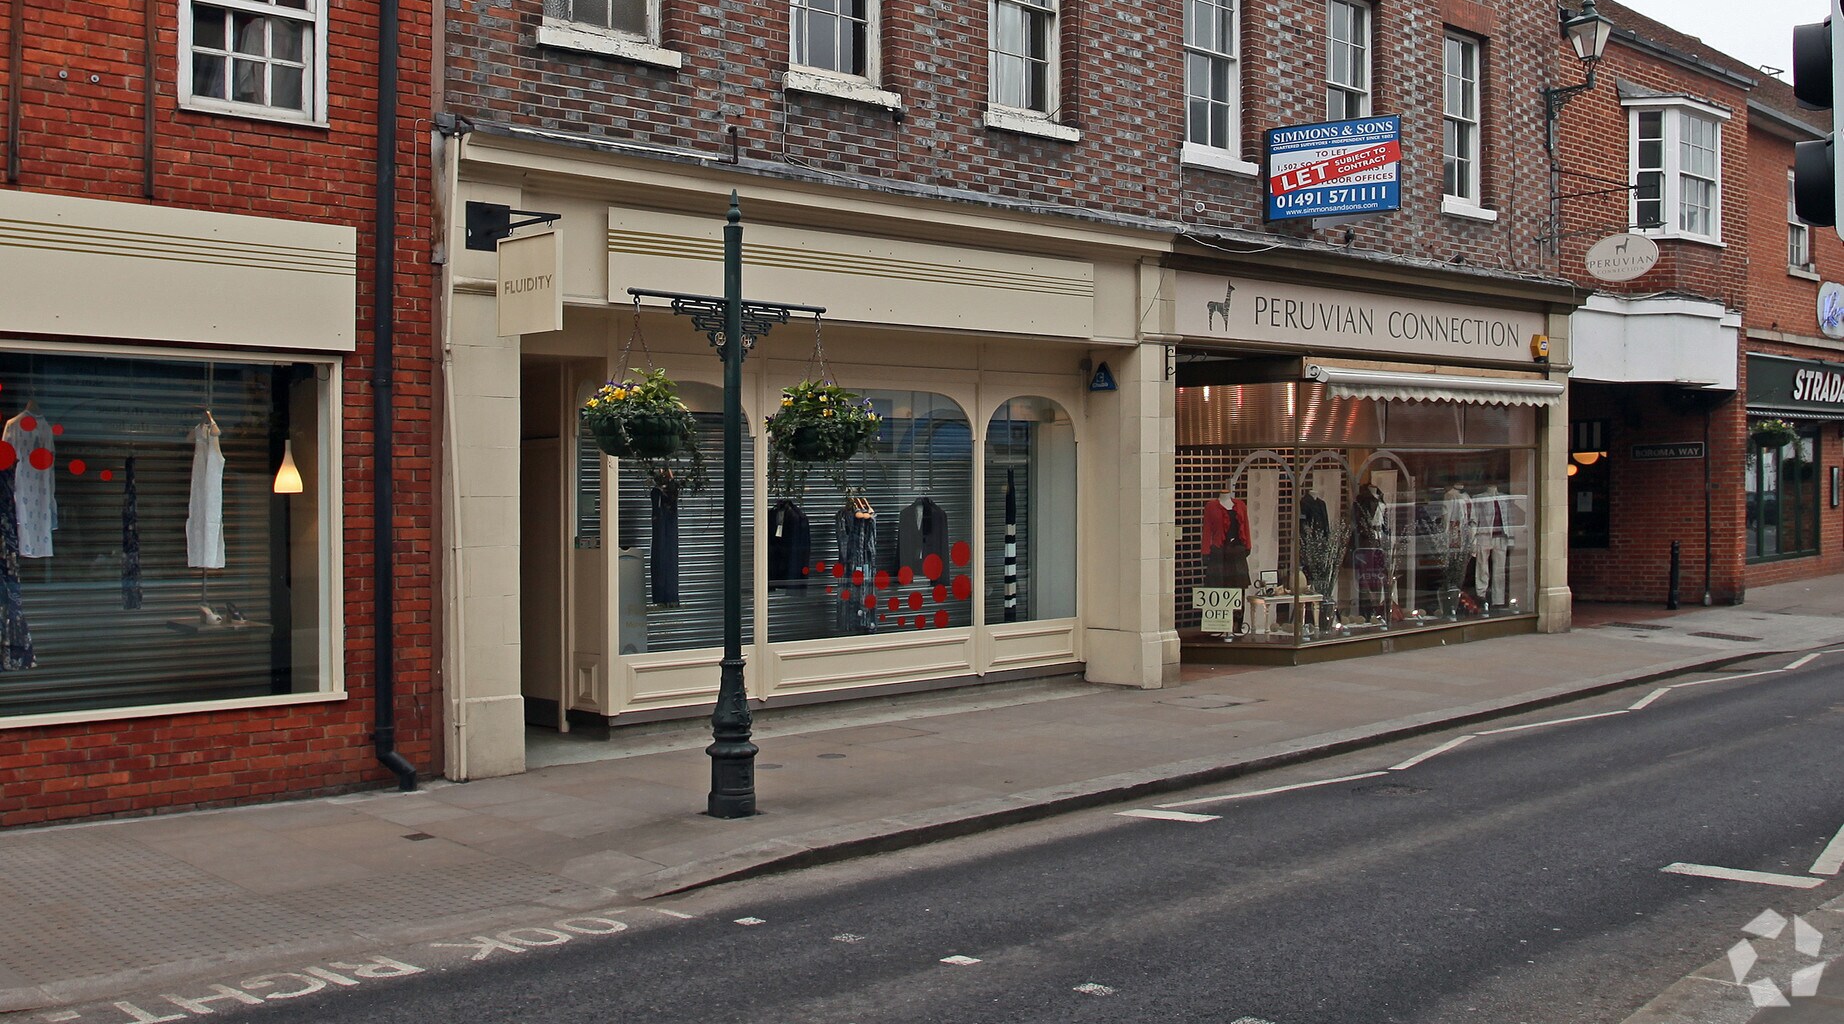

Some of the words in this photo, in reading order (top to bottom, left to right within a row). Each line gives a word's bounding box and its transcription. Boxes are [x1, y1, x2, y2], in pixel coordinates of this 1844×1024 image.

[1273, 127, 1338, 144] SIMMONS
[1342, 125, 1353, 136] &
[1356, 121, 1393, 135] SONS
[1273, 143, 1300, 151] CHARTERED
[1301, 140, 1328, 148] SURVEYORS
[1332, 136, 1366, 144] INDEPENDENT
[1316, 150, 1328, 158] TO
[1331, 148, 1347, 156] LET
[1334, 151, 1371, 167] SUBJECT
[1373, 146, 1386, 156] TO
[1337, 155, 1386, 173] CONTRACT
[1281, 162, 1329, 191] LET
[1354, 172, 1393, 182] OFFICES
[1276, 192, 1321, 209] 01491
[1328, 186, 1386, 204] 571111
[1285, 202, 1379, 216] www.simmonsandsons.com
[1589, 255, 1654, 269] PERUVIAN
[504, 274, 552, 295] FLUIDITY
[1254, 296, 1374, 336] PERUVIAN
[1388, 311, 1520, 348] CONNECTION
[1793, 368, 1844, 403] STRADA
[1678, 447, 1700, 456] WAY
[1196, 590, 1241, 607] 30%
[1205, 609, 1229, 619] OFF
[430, 906, 693, 961] LOOK
[112, 953, 426, 1024] RIGHT
